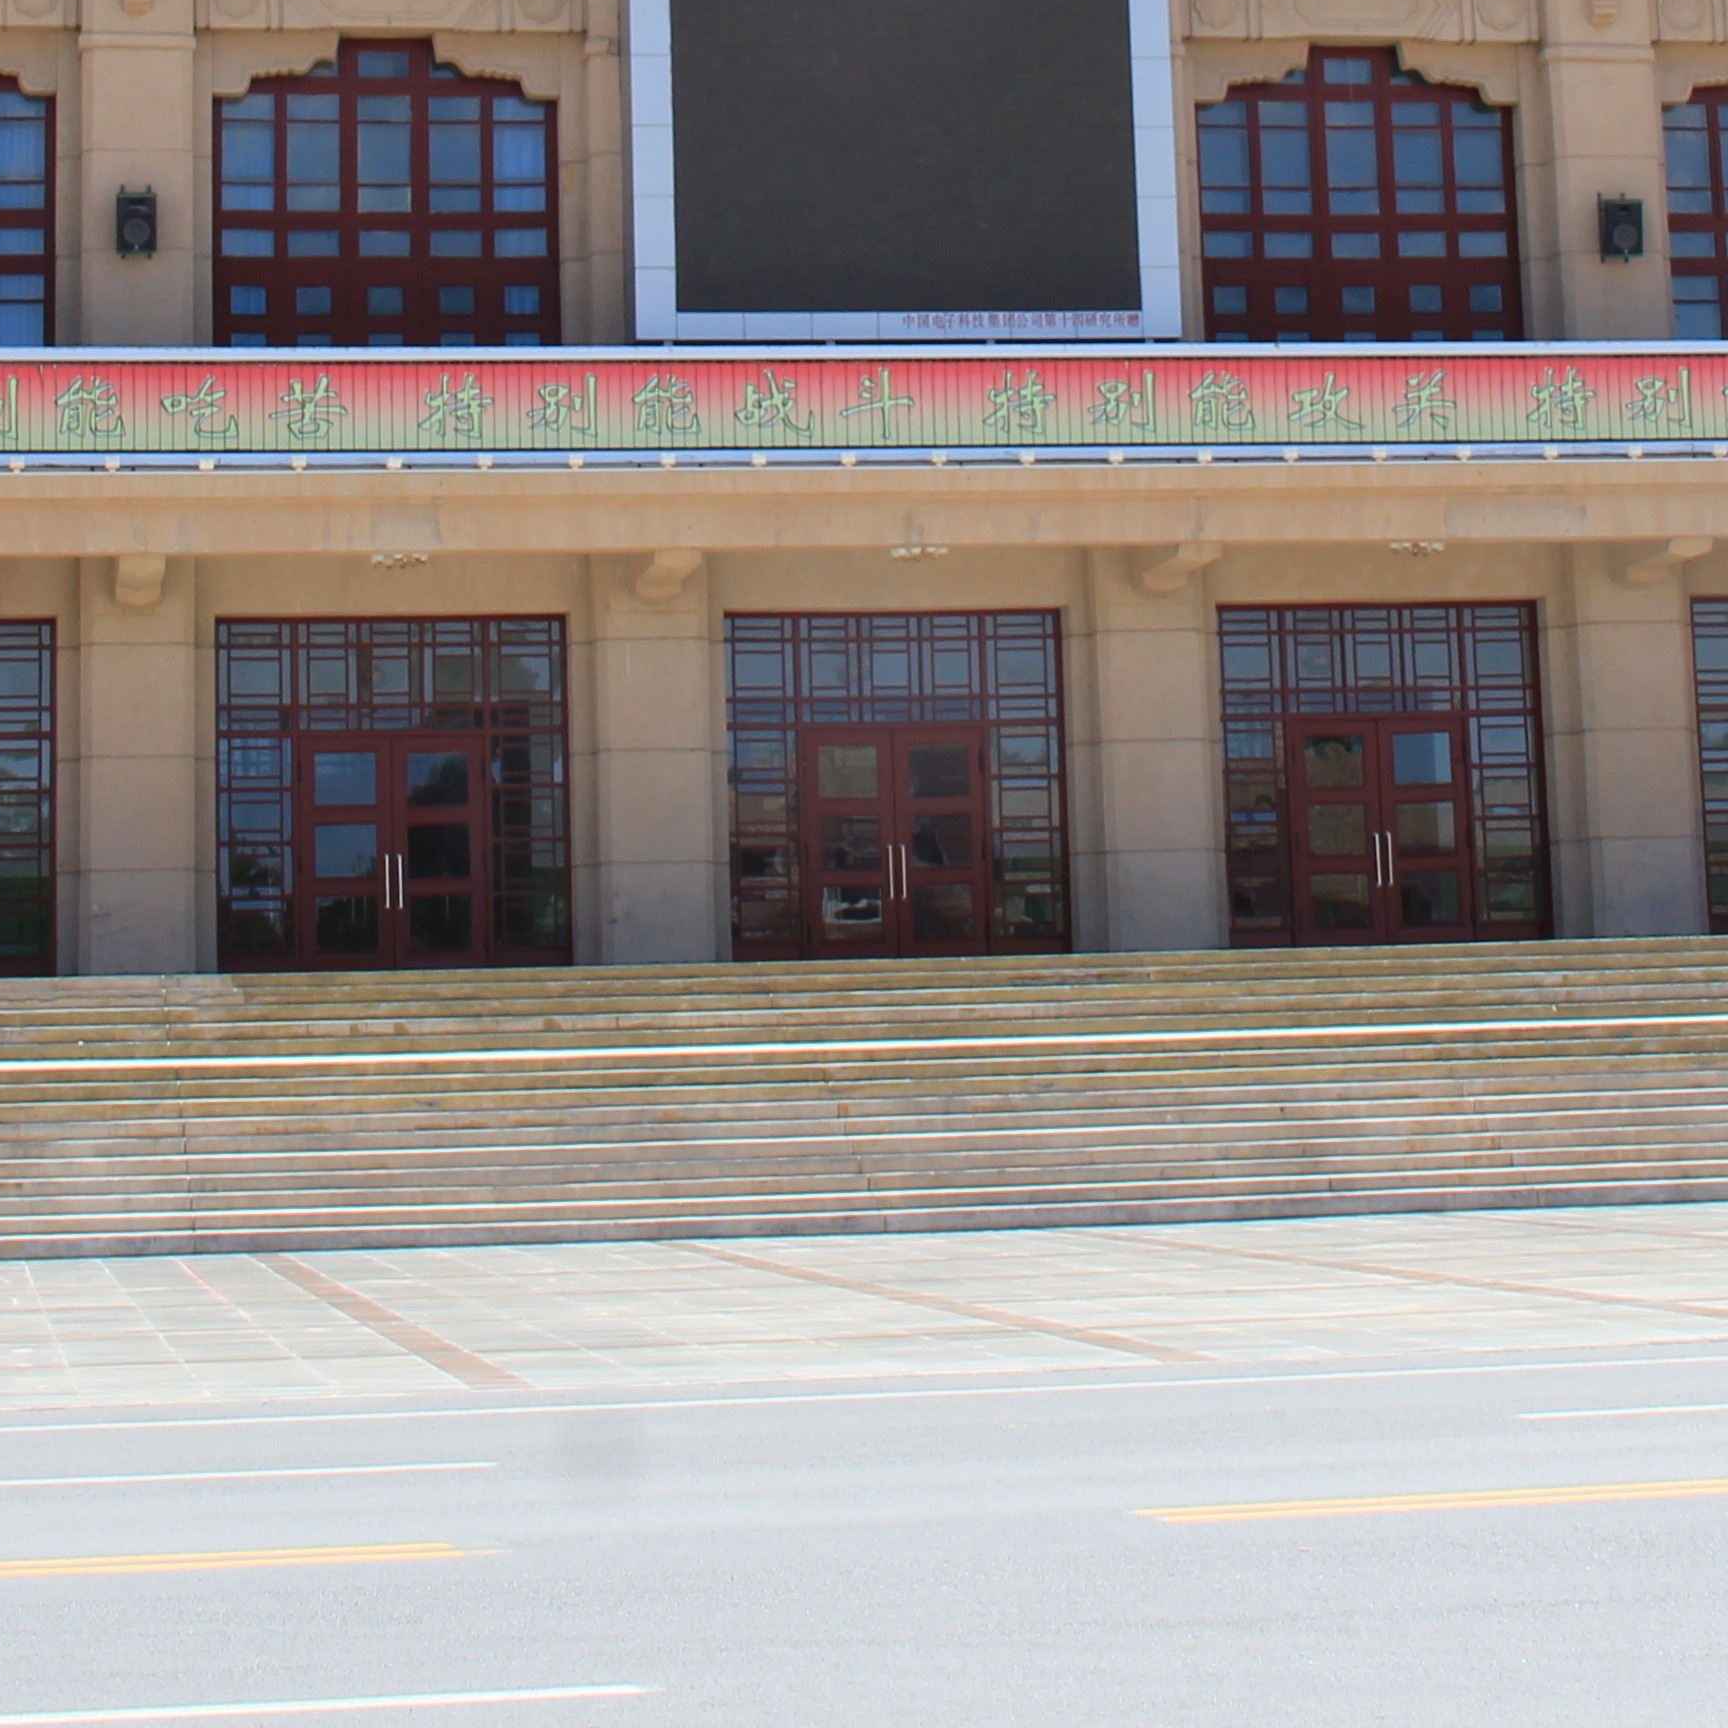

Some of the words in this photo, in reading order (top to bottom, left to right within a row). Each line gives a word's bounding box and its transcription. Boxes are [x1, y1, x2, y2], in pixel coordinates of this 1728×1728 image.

[418, 368, 915, 440] 特别能战斗
[982, 368, 1457, 435] 特别能攻关
